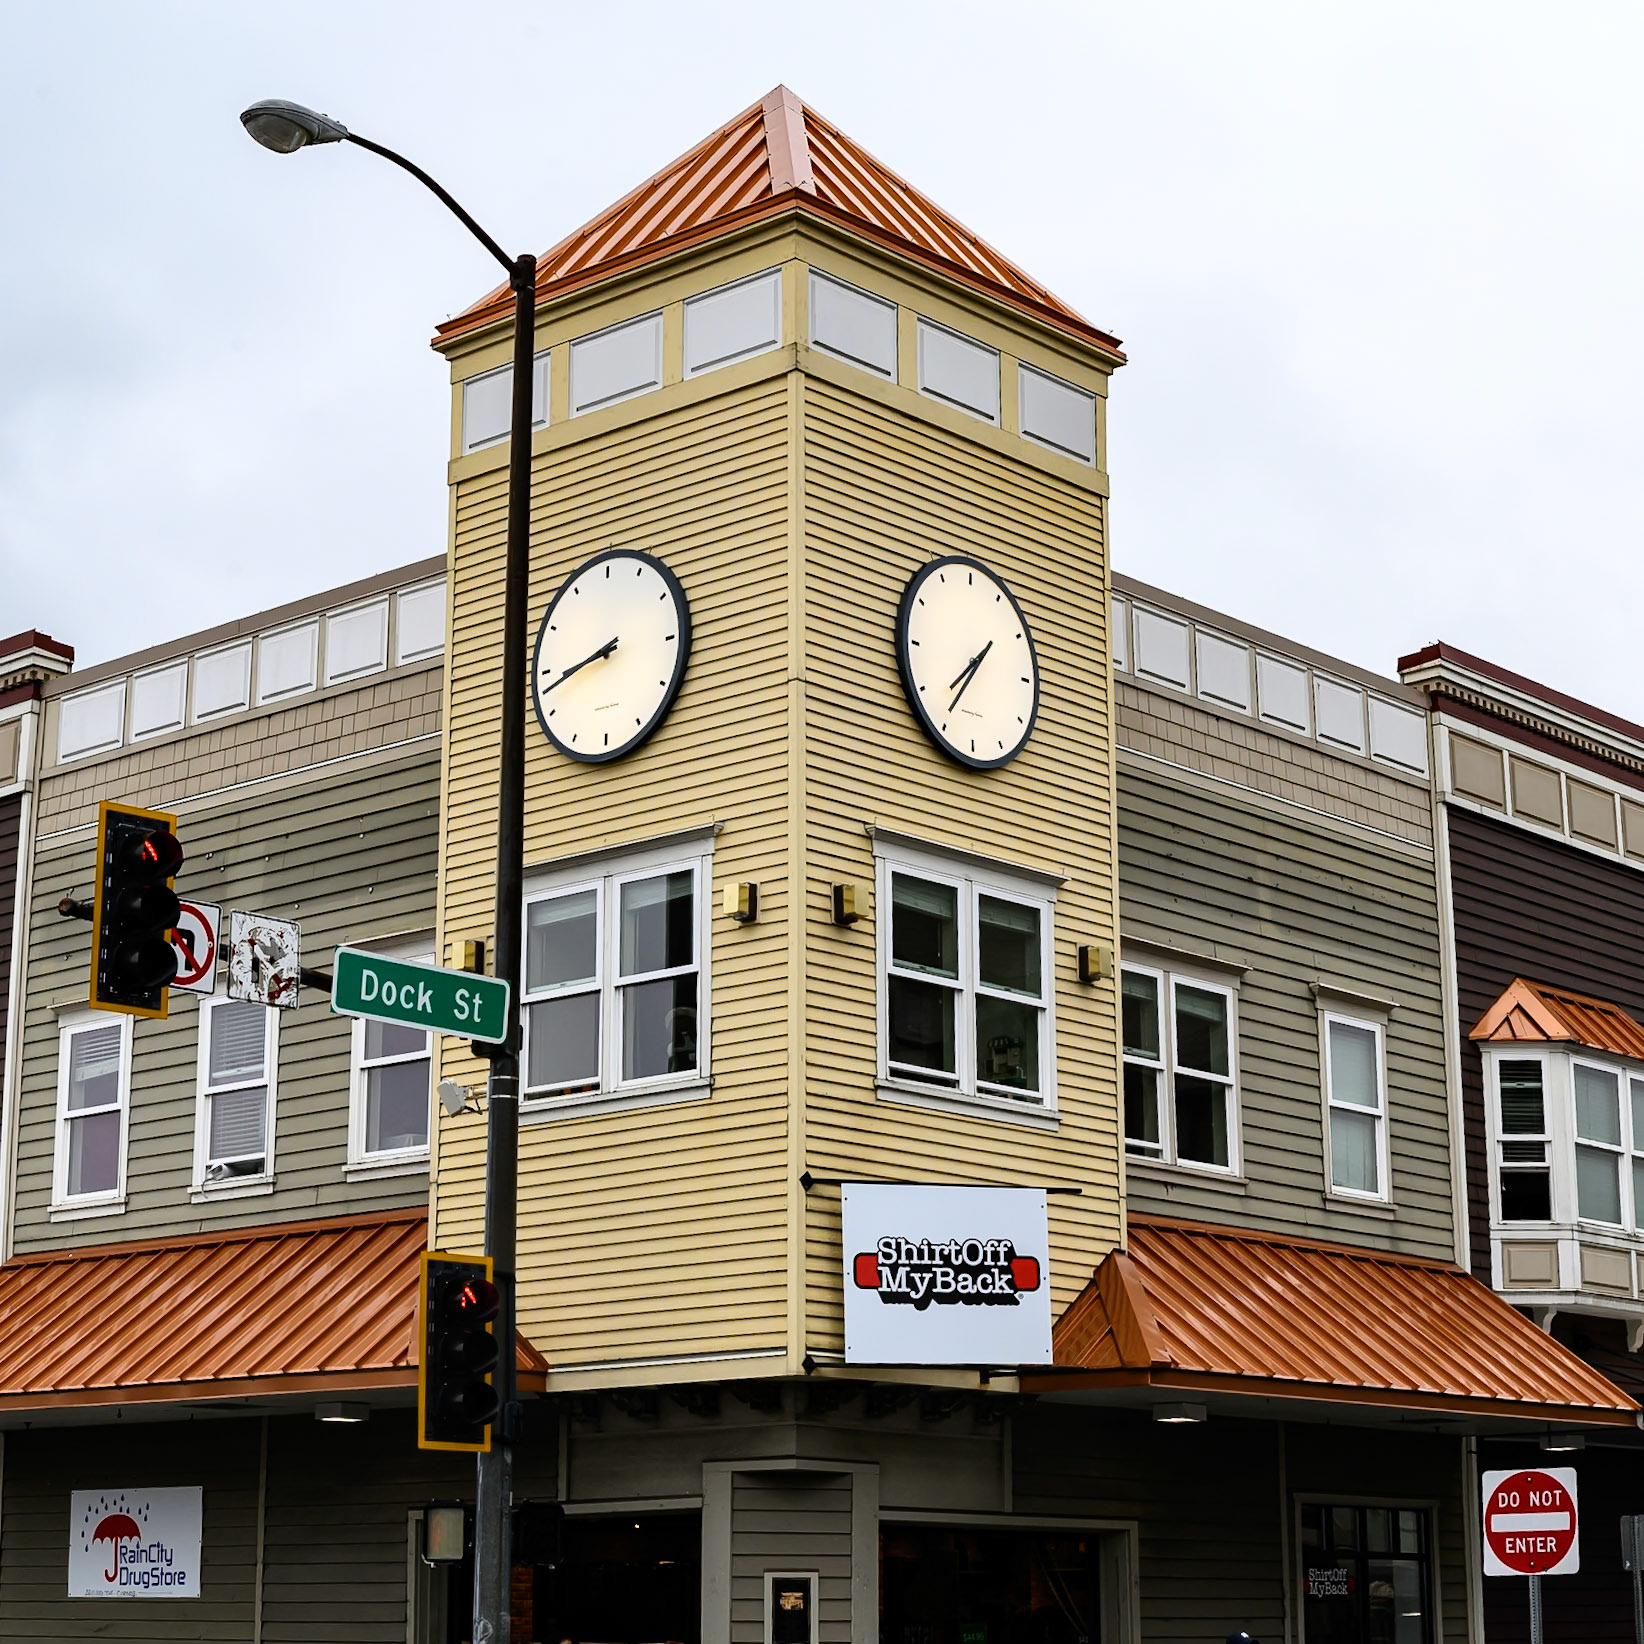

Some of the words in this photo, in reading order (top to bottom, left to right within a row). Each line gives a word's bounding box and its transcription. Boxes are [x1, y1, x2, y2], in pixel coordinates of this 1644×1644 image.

[360, 969, 433, 1014] Dock
[453, 988, 484, 1023] St
[877, 1236, 1013, 1268] ShirtOff
[877, 1266, 1015, 1300] MyBack
[1497, 1491, 1520, 1508] DO
[1528, 1490, 1562, 1507] NOT
[119, 1541, 173, 1566] RainCity
[1505, 1536, 1557, 1554] ENTER
[119, 1567, 186, 1589] DrugStore
[1308, 1568, 1348, 1581] ShirtOff
[1309, 1581, 1349, 1598] MyBack
